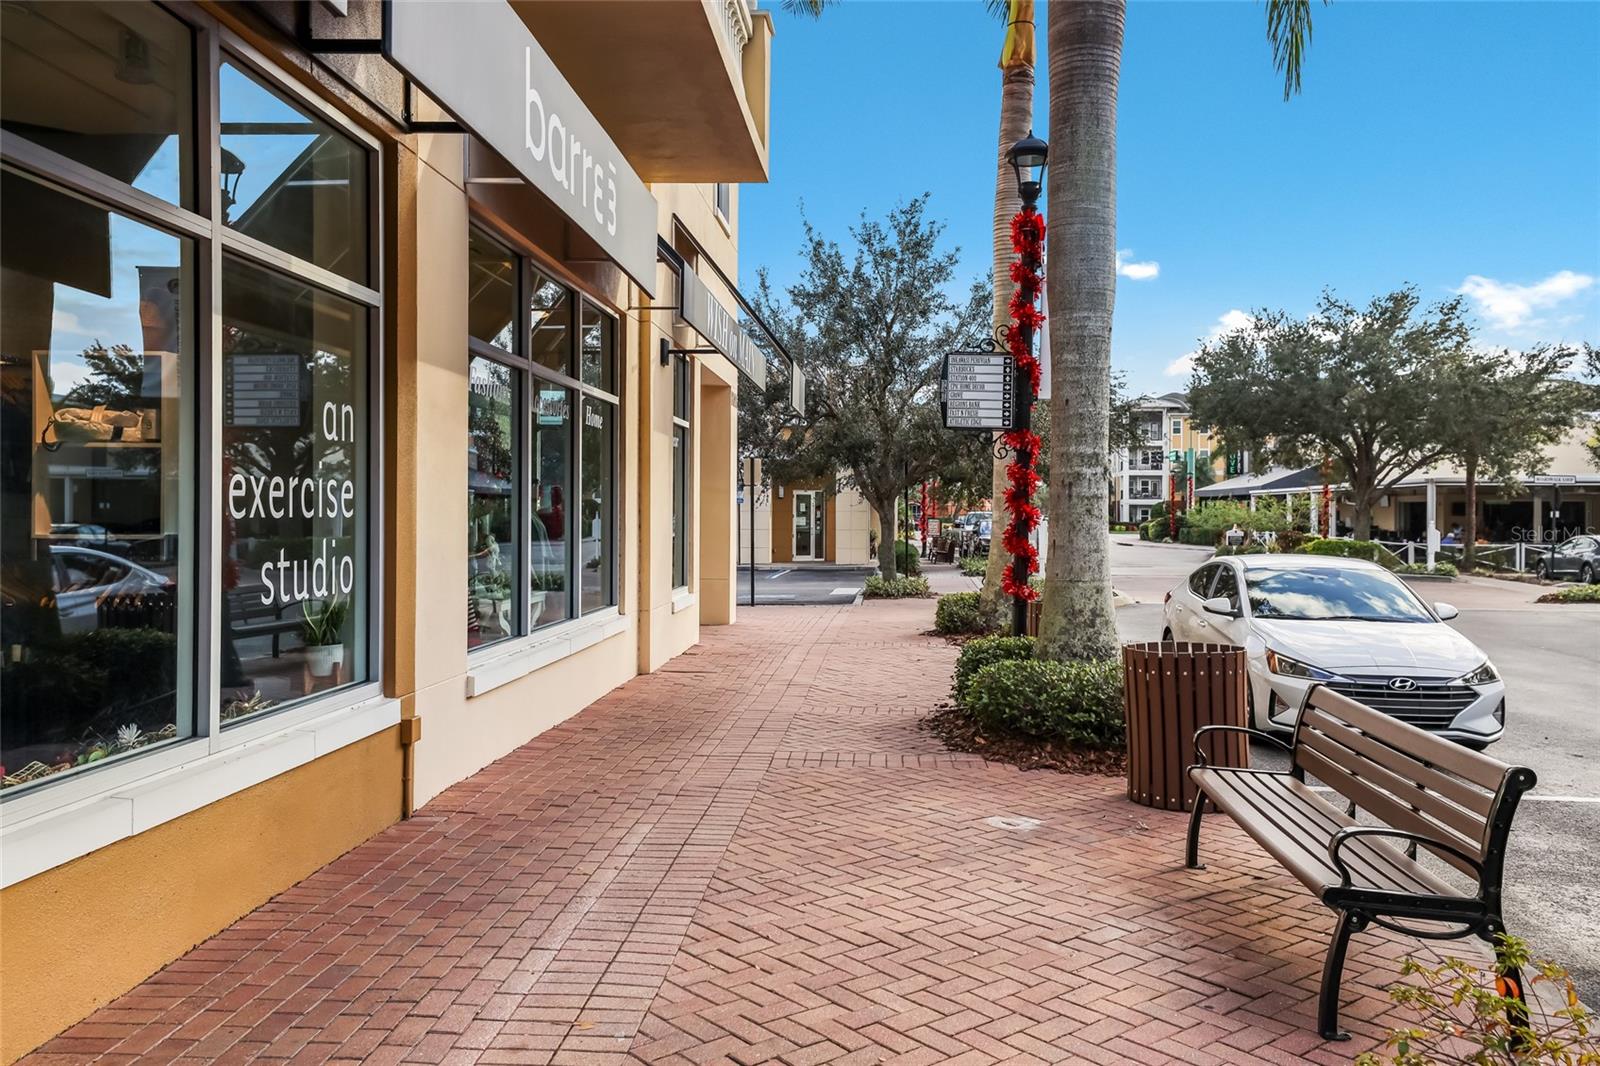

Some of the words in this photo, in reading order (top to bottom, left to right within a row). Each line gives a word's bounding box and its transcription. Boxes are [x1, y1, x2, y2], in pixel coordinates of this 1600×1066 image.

[707, 291, 729, 350] WISH
[323, 401, 354, 442] an
[585, 405, 604, 430] Home
[228, 461, 354, 519] exercise
[261, 537, 354, 606] studio
